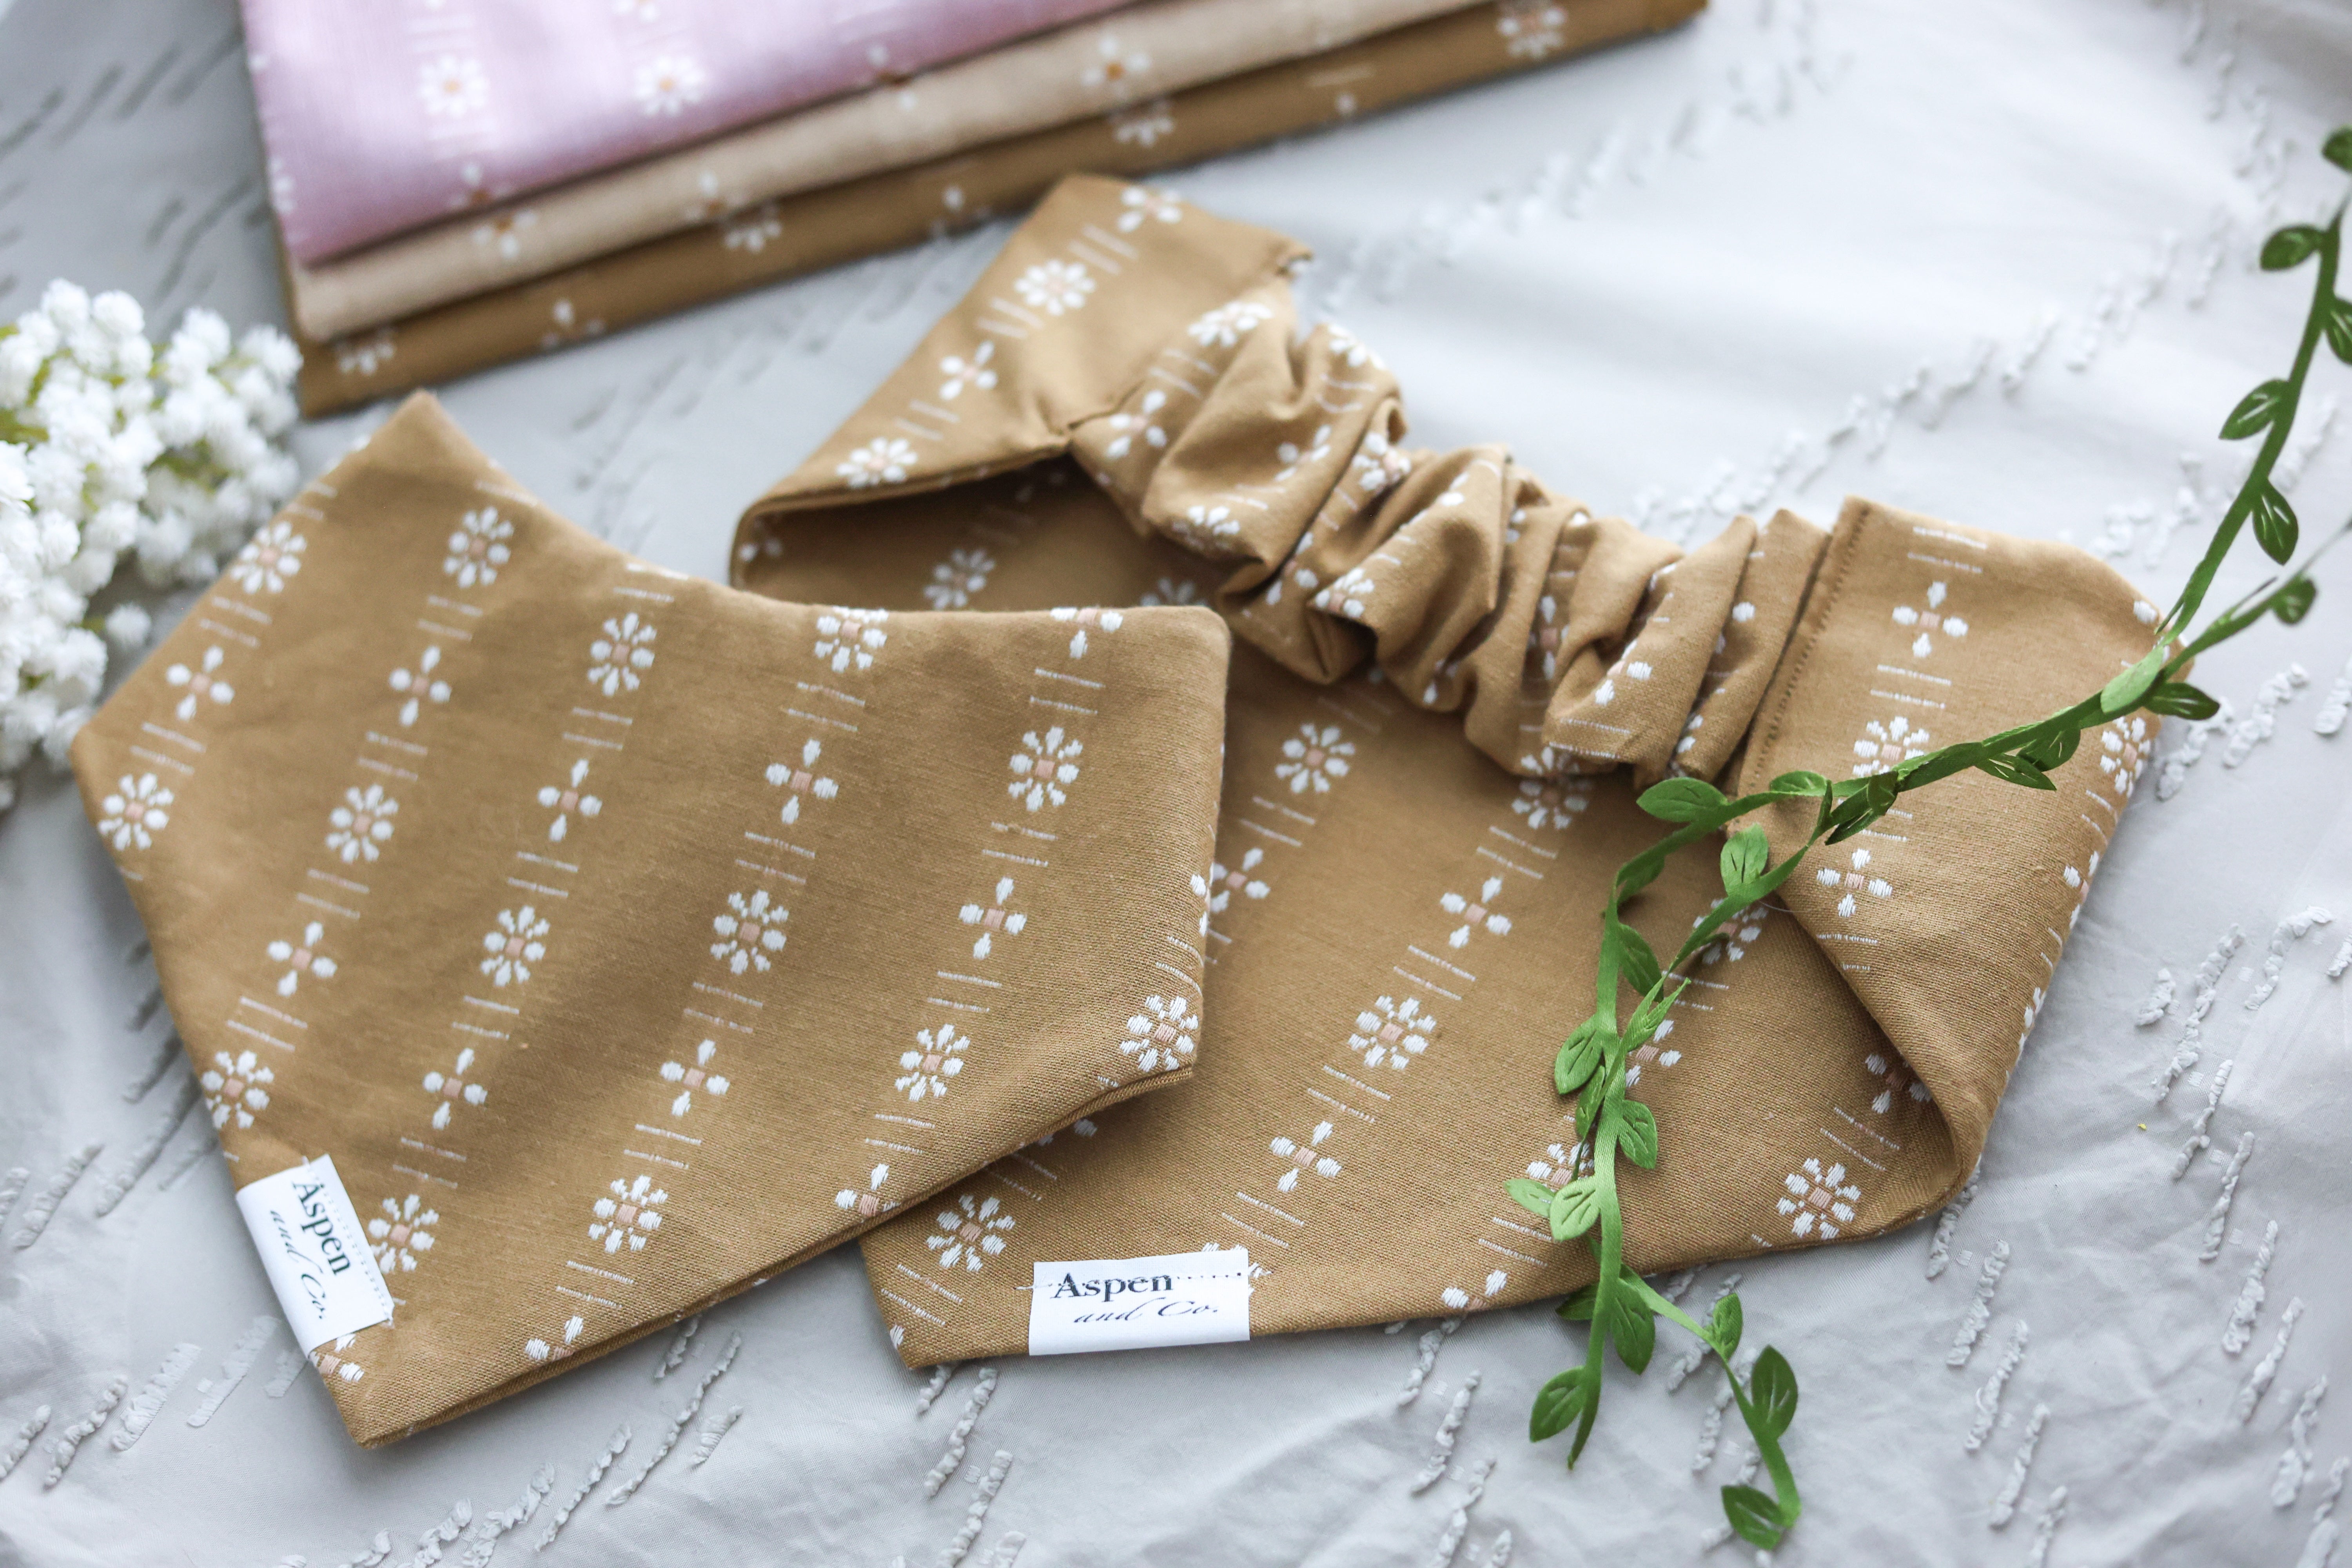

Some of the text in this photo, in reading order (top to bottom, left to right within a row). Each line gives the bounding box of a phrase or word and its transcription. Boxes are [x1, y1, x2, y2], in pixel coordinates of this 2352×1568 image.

[293, 1180, 351, 1276] Aspen
[270, 1209, 327, 1319] and Co.
[1050, 1272, 1173, 1302] Aspen
[1074, 1297, 1218, 1323] and Co.
